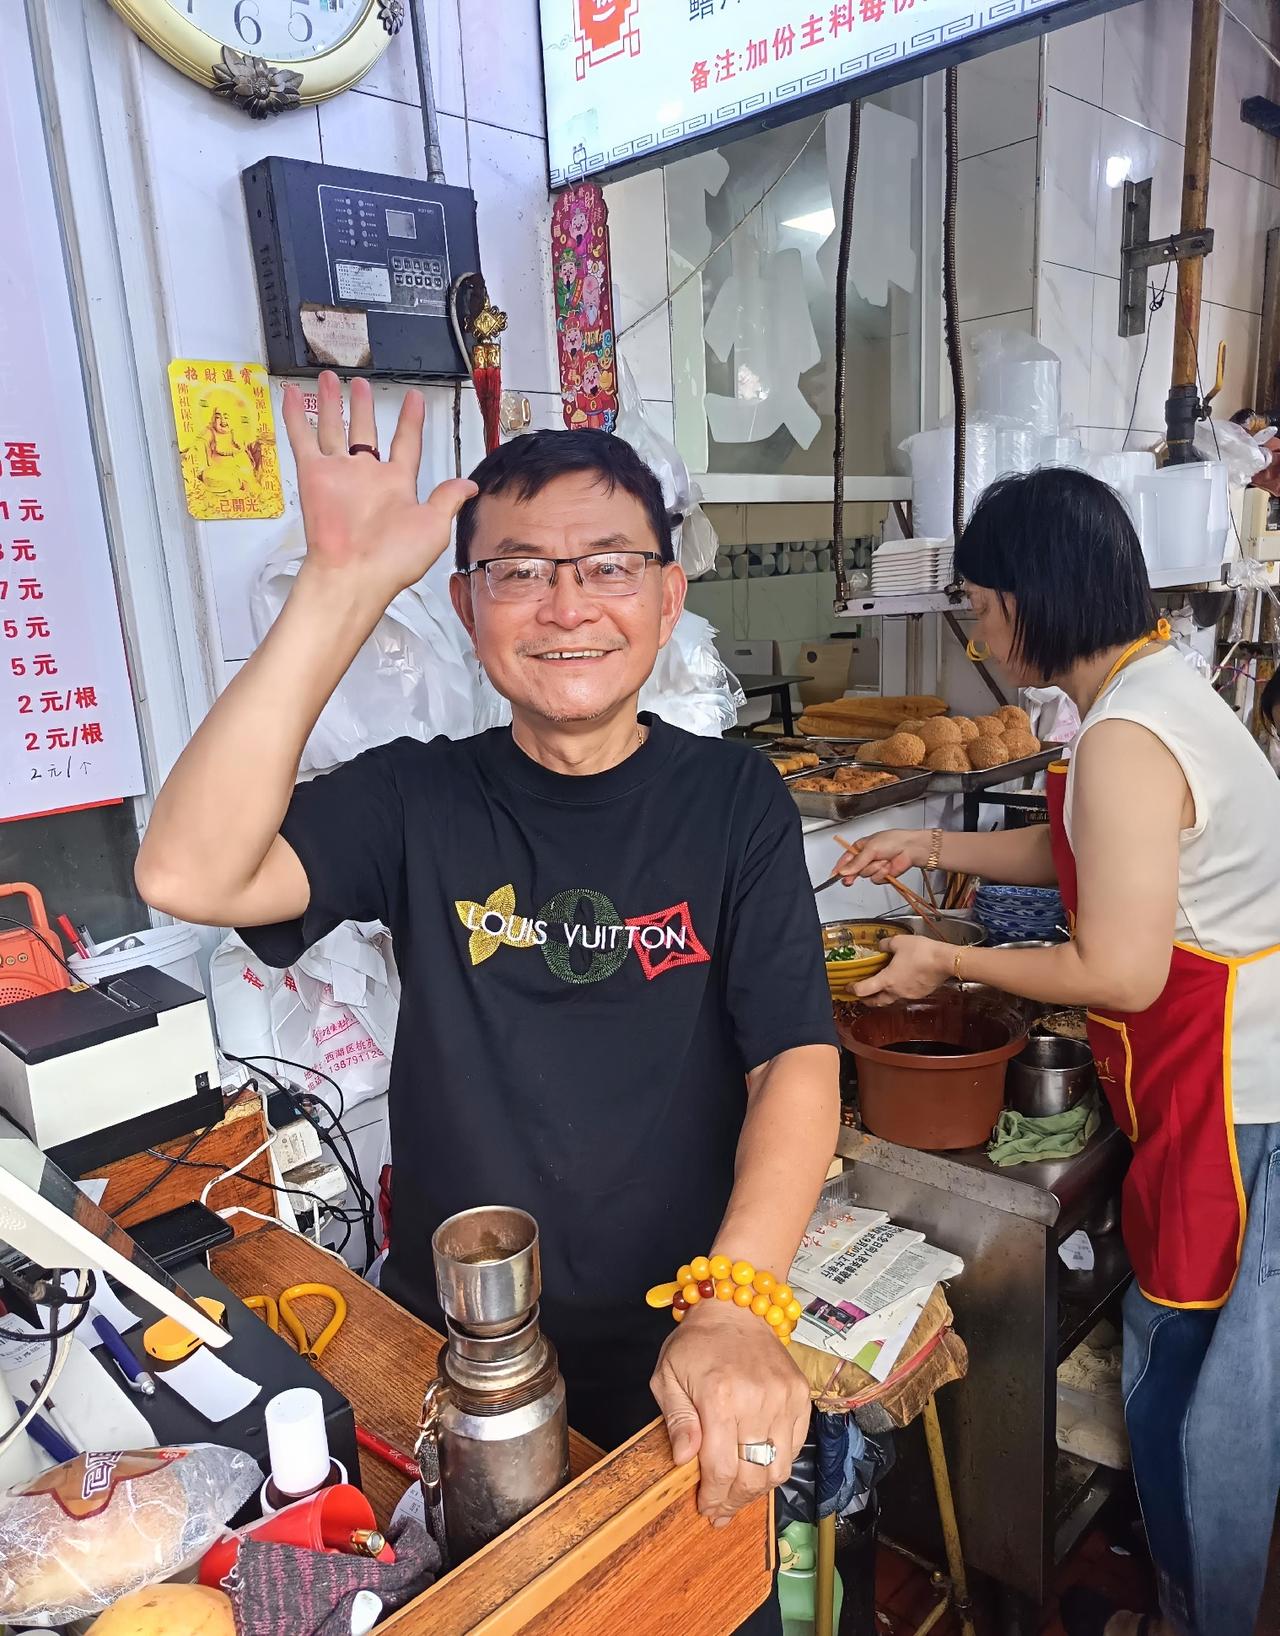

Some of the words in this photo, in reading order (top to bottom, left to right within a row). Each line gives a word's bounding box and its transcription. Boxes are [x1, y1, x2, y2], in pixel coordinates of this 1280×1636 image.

[234, 0, 262, 45] 6
[288, 0, 313, 42] 5
[0, 442, 42, 477] 蛋
[466, 905, 548, 945] LOUIS
[563, 923, 687, 950] VUITTON
